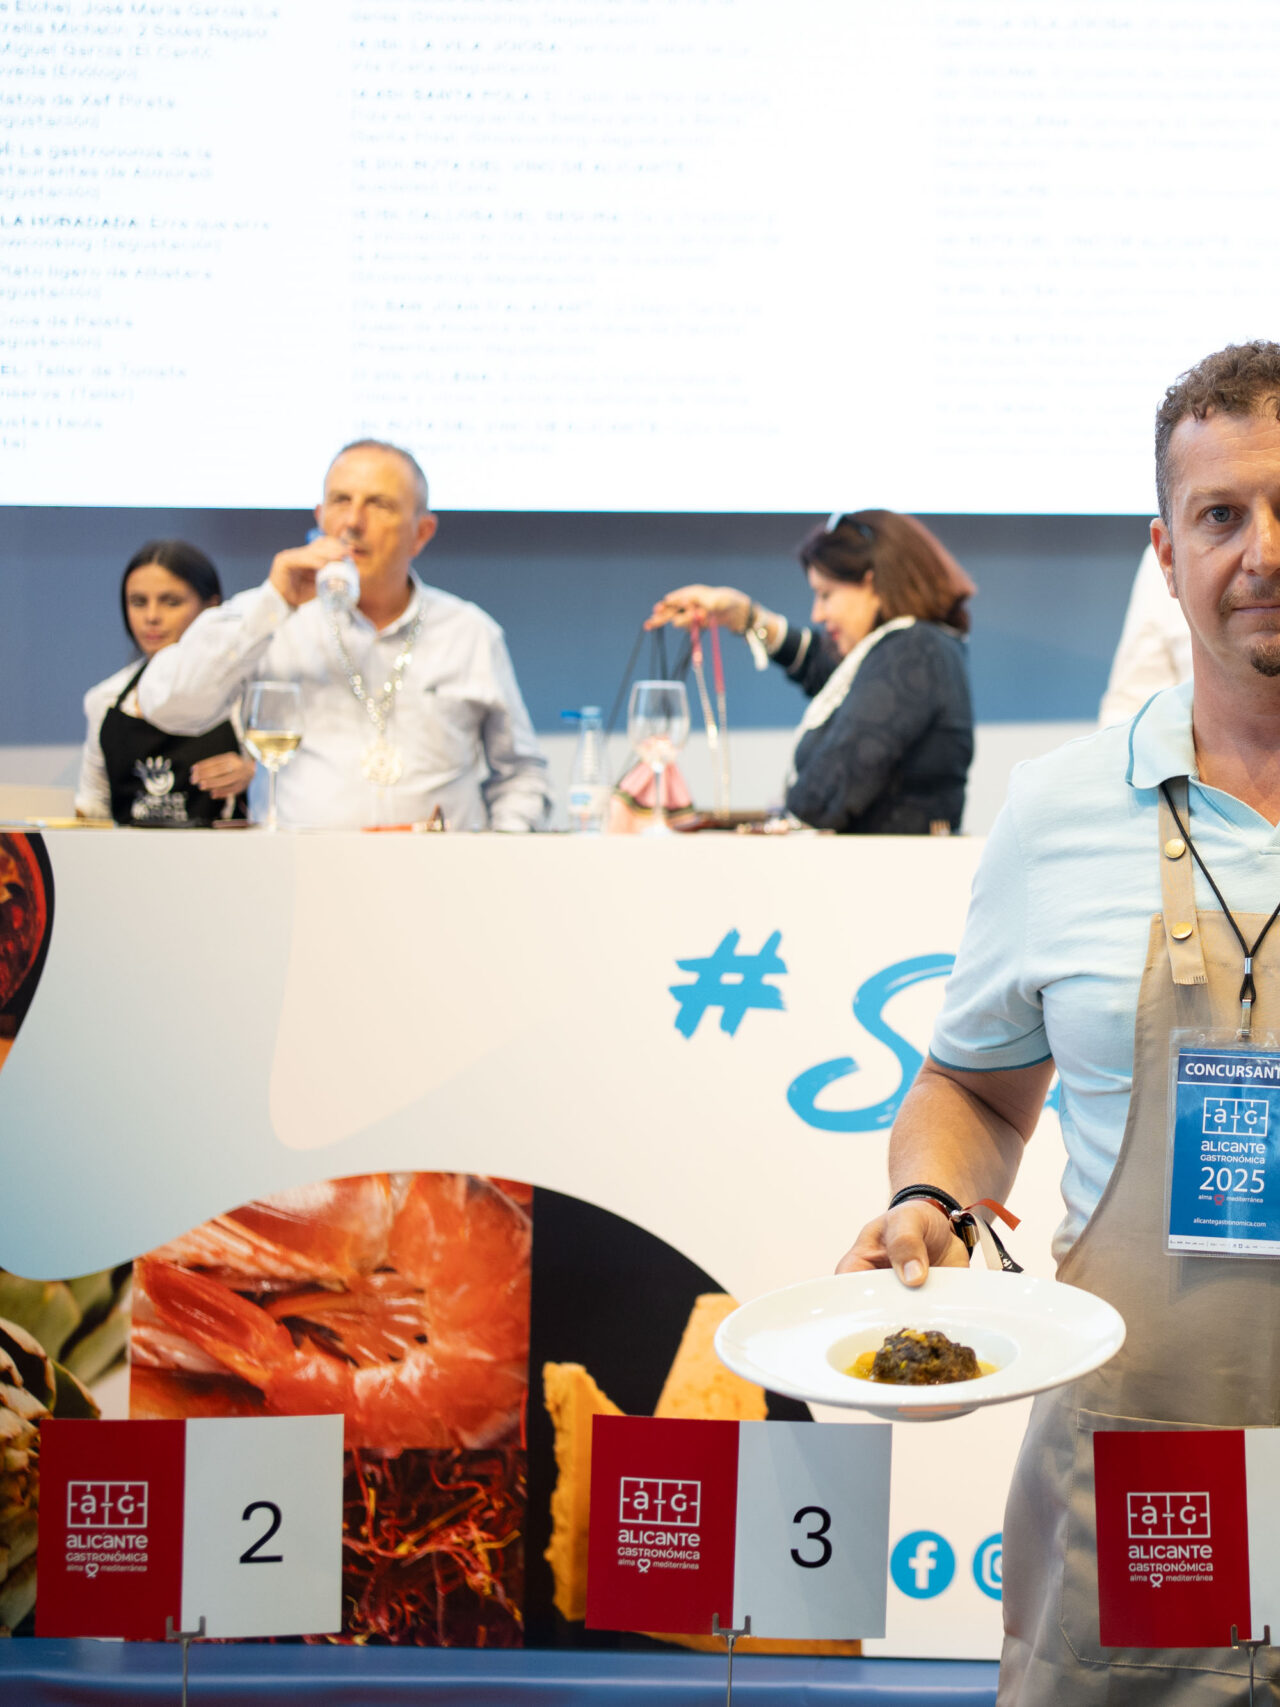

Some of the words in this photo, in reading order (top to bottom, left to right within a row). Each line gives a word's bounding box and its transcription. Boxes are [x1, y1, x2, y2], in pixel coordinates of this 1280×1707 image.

[1199, 1166, 1266, 1193] 2025
[239, 1500, 283, 1564] 2
[790, 1506, 833, 1569] 3
